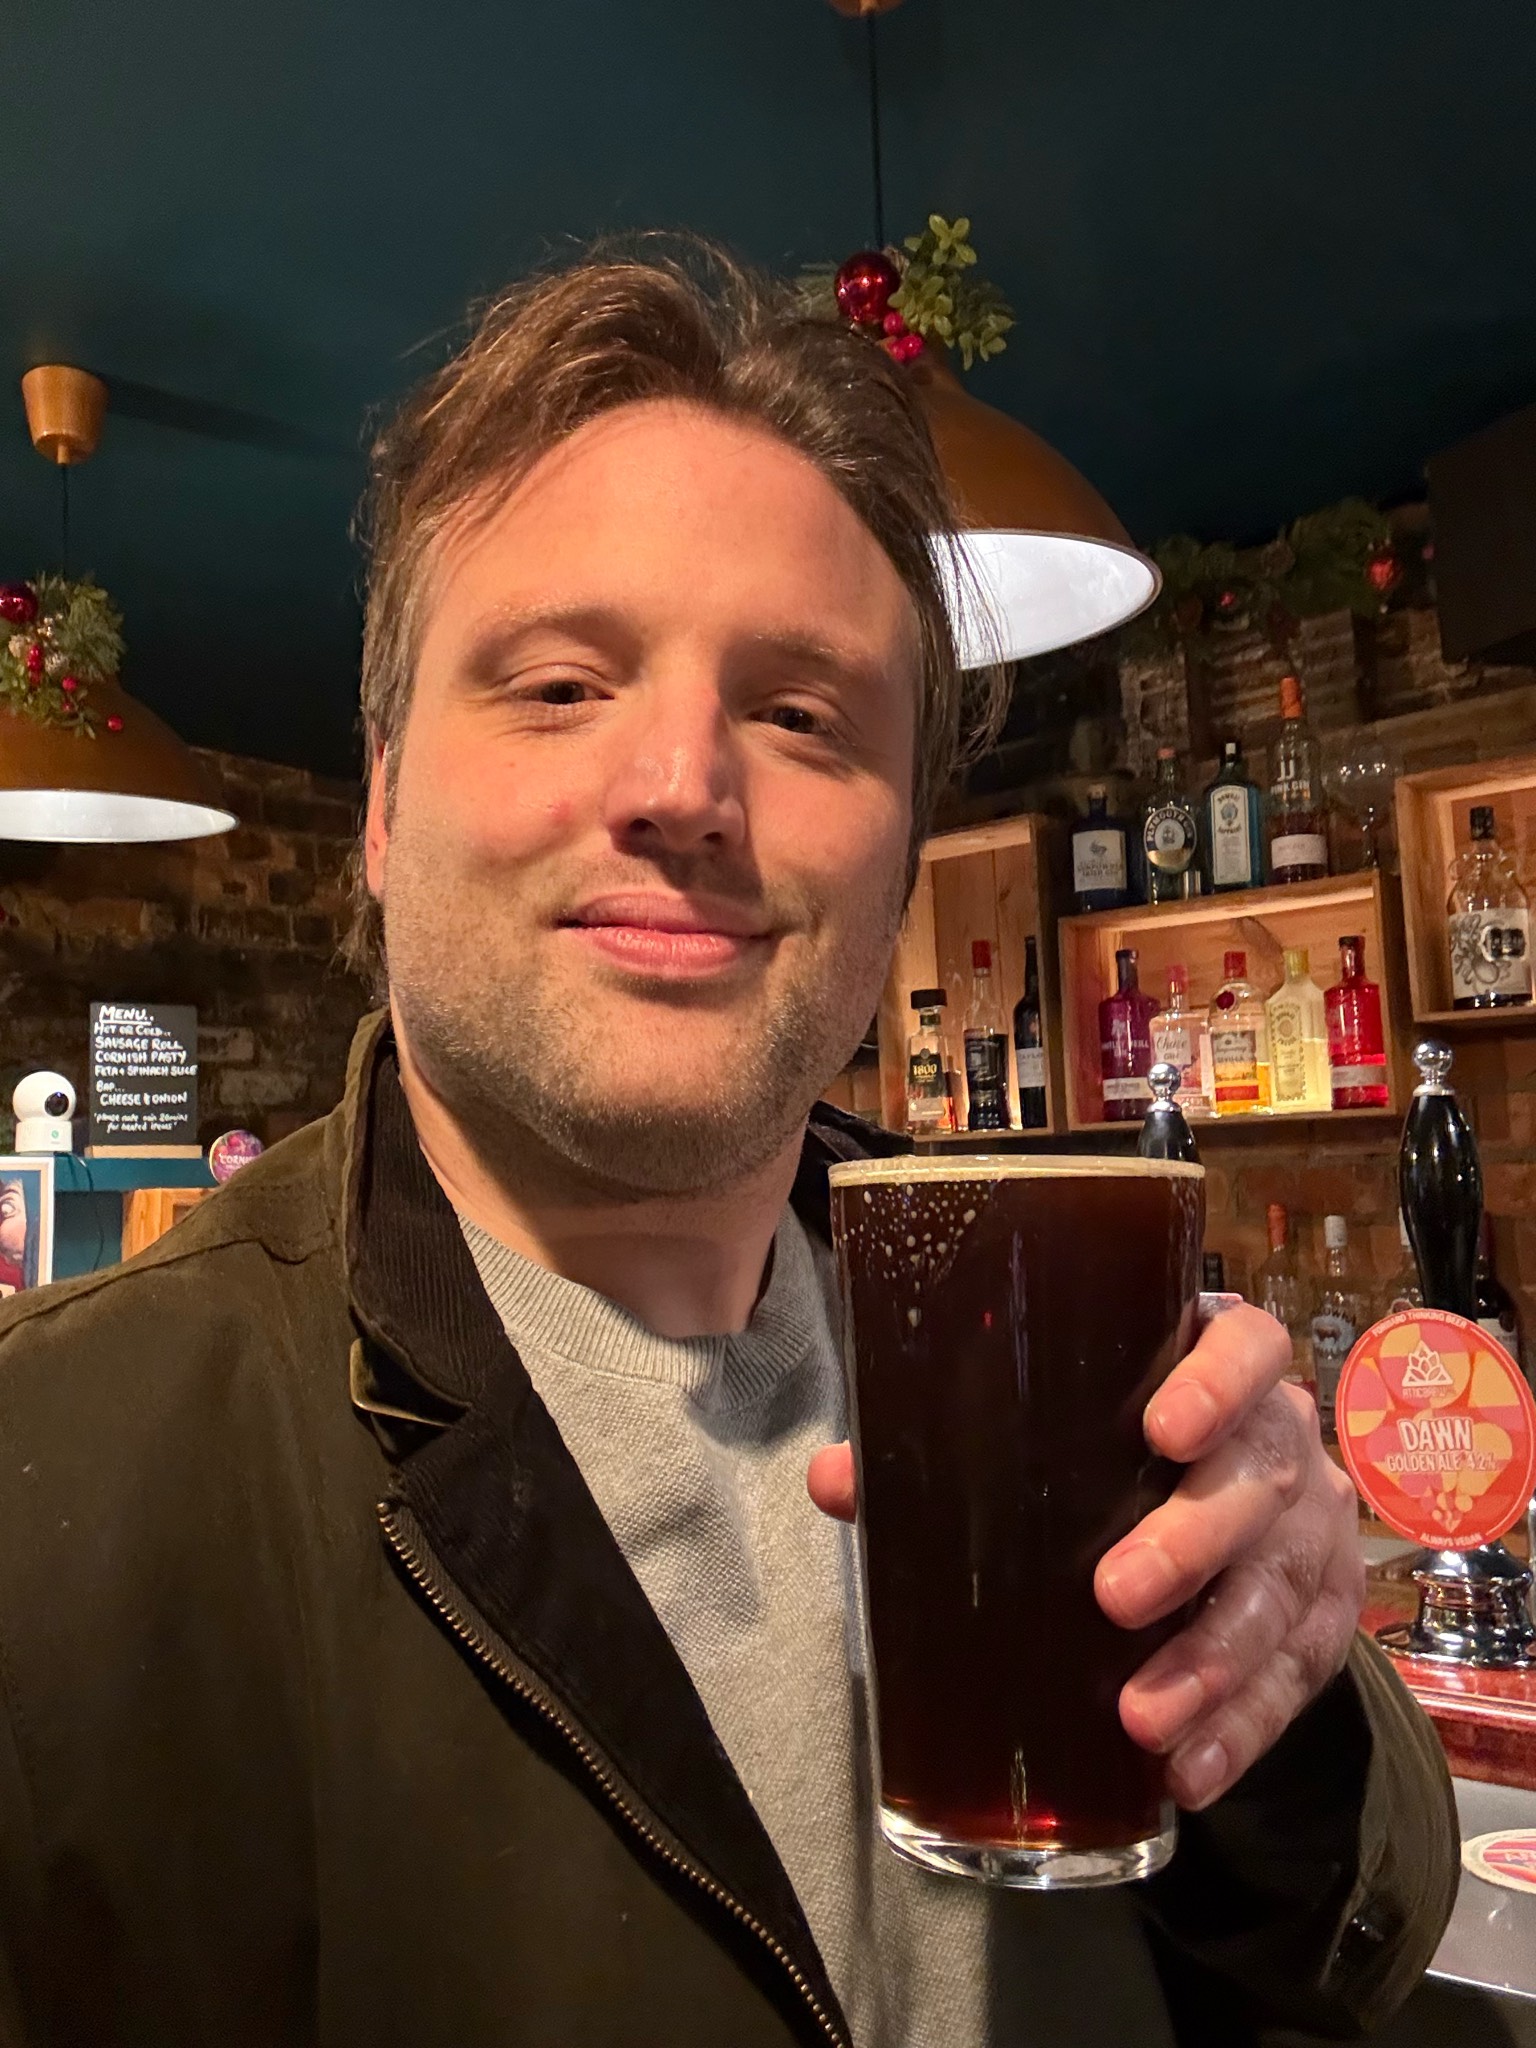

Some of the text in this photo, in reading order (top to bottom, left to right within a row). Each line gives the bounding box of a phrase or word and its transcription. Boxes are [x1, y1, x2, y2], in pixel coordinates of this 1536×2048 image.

[94, 1022, 117, 1035] HOT
[119, 1025, 134, 1035] OR
[95, 1036, 183, 1051] SAUSAGE ROLL
[95, 1050, 187, 1064] CORNISH PASTY
[94, 1065, 119, 1078] FETA
[127, 1065, 169, 1077] SPINACH
[170, 1064, 198, 1077] SLICE
[912, 1063, 938, 1076] 1800
[100, 1093, 141, 1106] CHEESE
[151, 1091, 188, 1105] ONION
[121, 1121, 148, 1132] heated
[1371, 1313, 1407, 1338] FORWARD
[1406, 1311, 1445, 1321] THINKING
[1445, 1314, 1468, 1329] BEER
[1398, 1418, 1473, 1452] DAWN
[1387, 1453, 1436, 1472] GOLDEN
[1439, 1453, 1461, 1472] ALE
[1420, 1531, 1483, 1547] ALWAYS VEGAN
